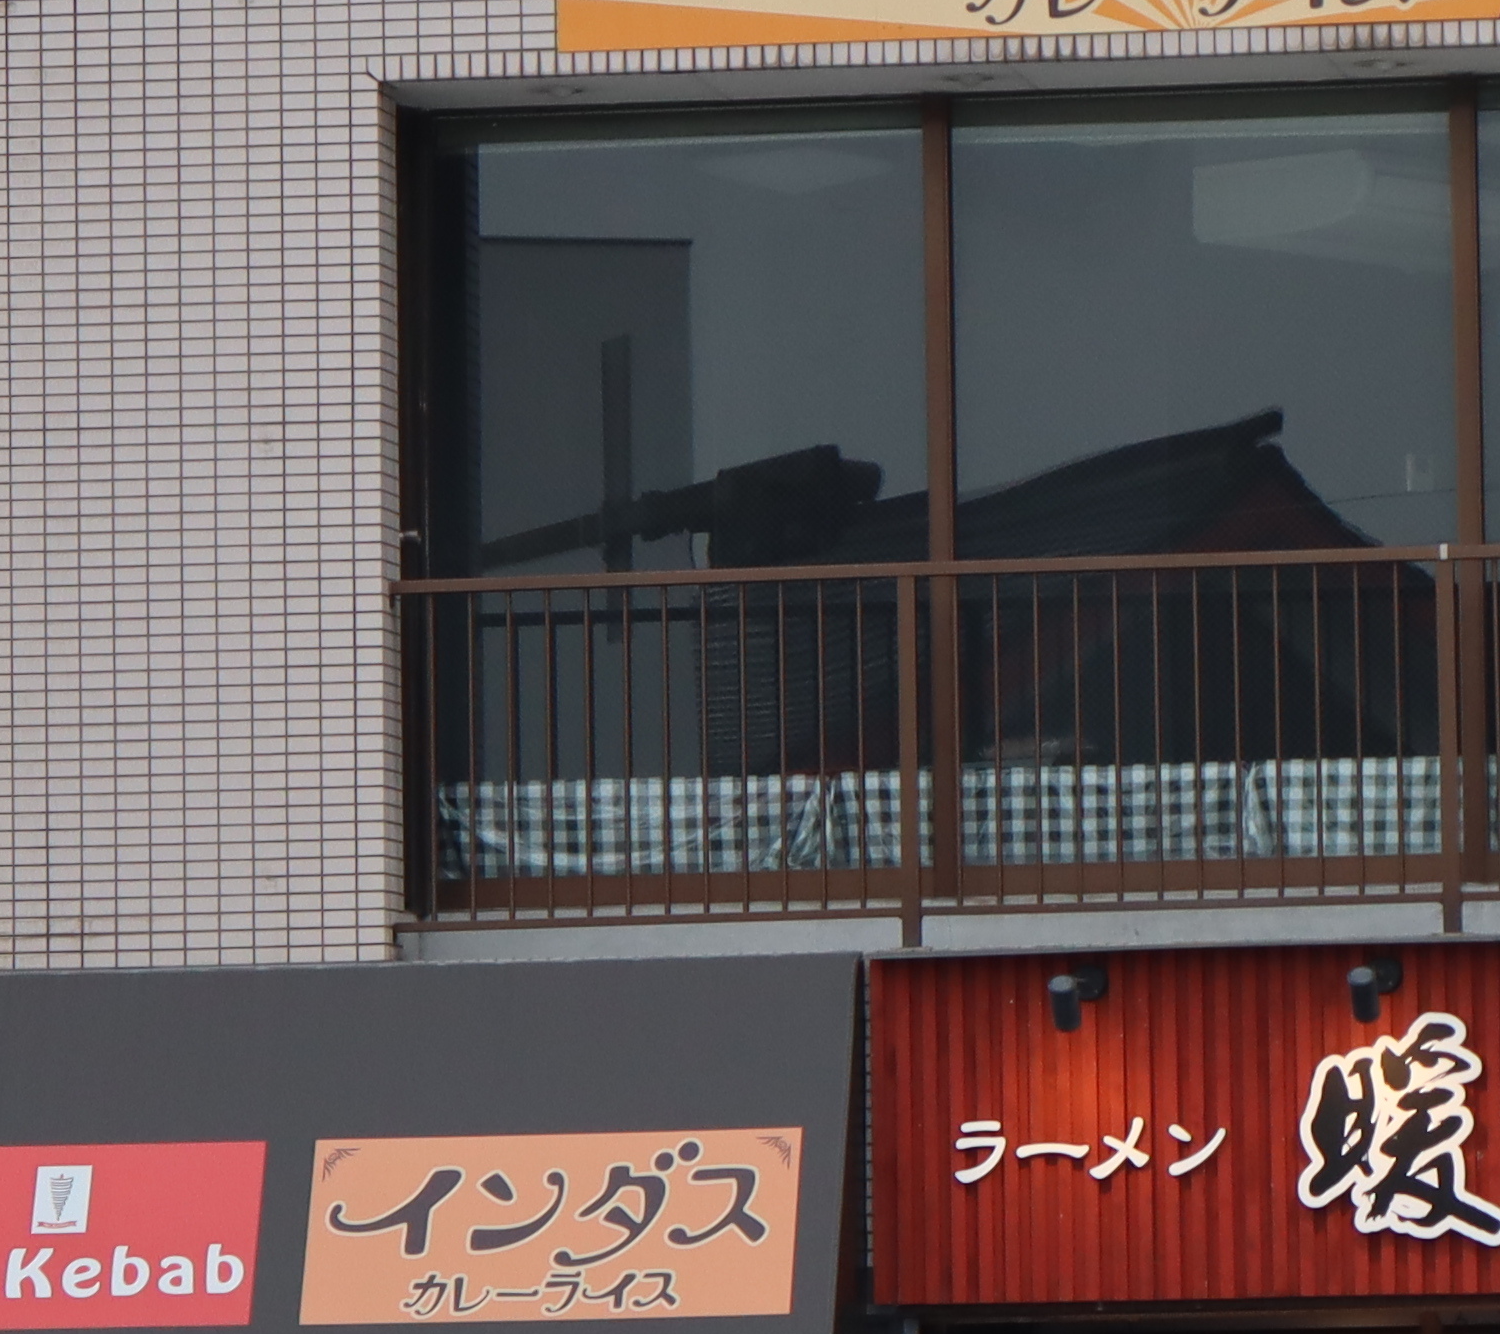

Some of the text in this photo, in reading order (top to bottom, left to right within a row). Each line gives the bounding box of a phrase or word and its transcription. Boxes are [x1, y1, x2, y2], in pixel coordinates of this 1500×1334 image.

[953, 1118, 1227, 1185] ラーメン
[326, 1139, 769, 1269] インダス
[402, 1269, 681, 1317] カレーライス
